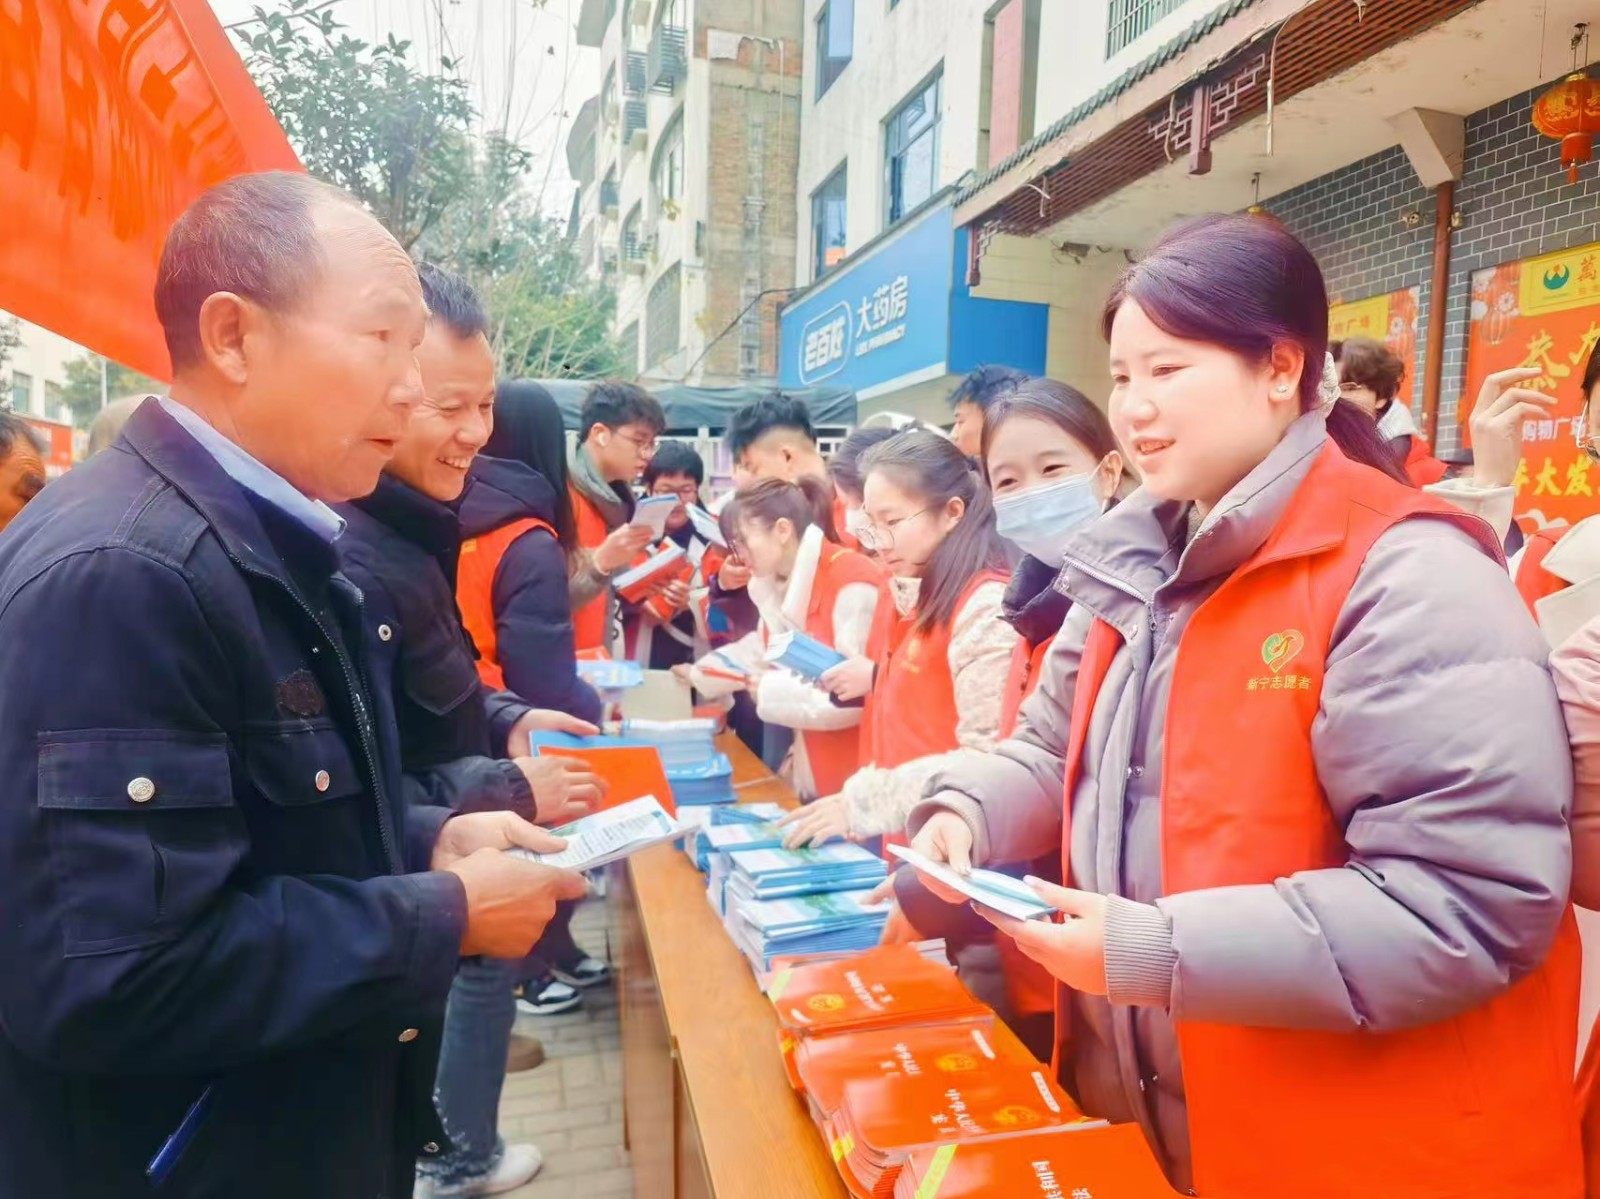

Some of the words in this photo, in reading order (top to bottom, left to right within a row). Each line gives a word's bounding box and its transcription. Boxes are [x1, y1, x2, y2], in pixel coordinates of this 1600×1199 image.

[855, 275, 909, 339] 大药房
[1246, 674, 1312, 691] 新宁志愿者
